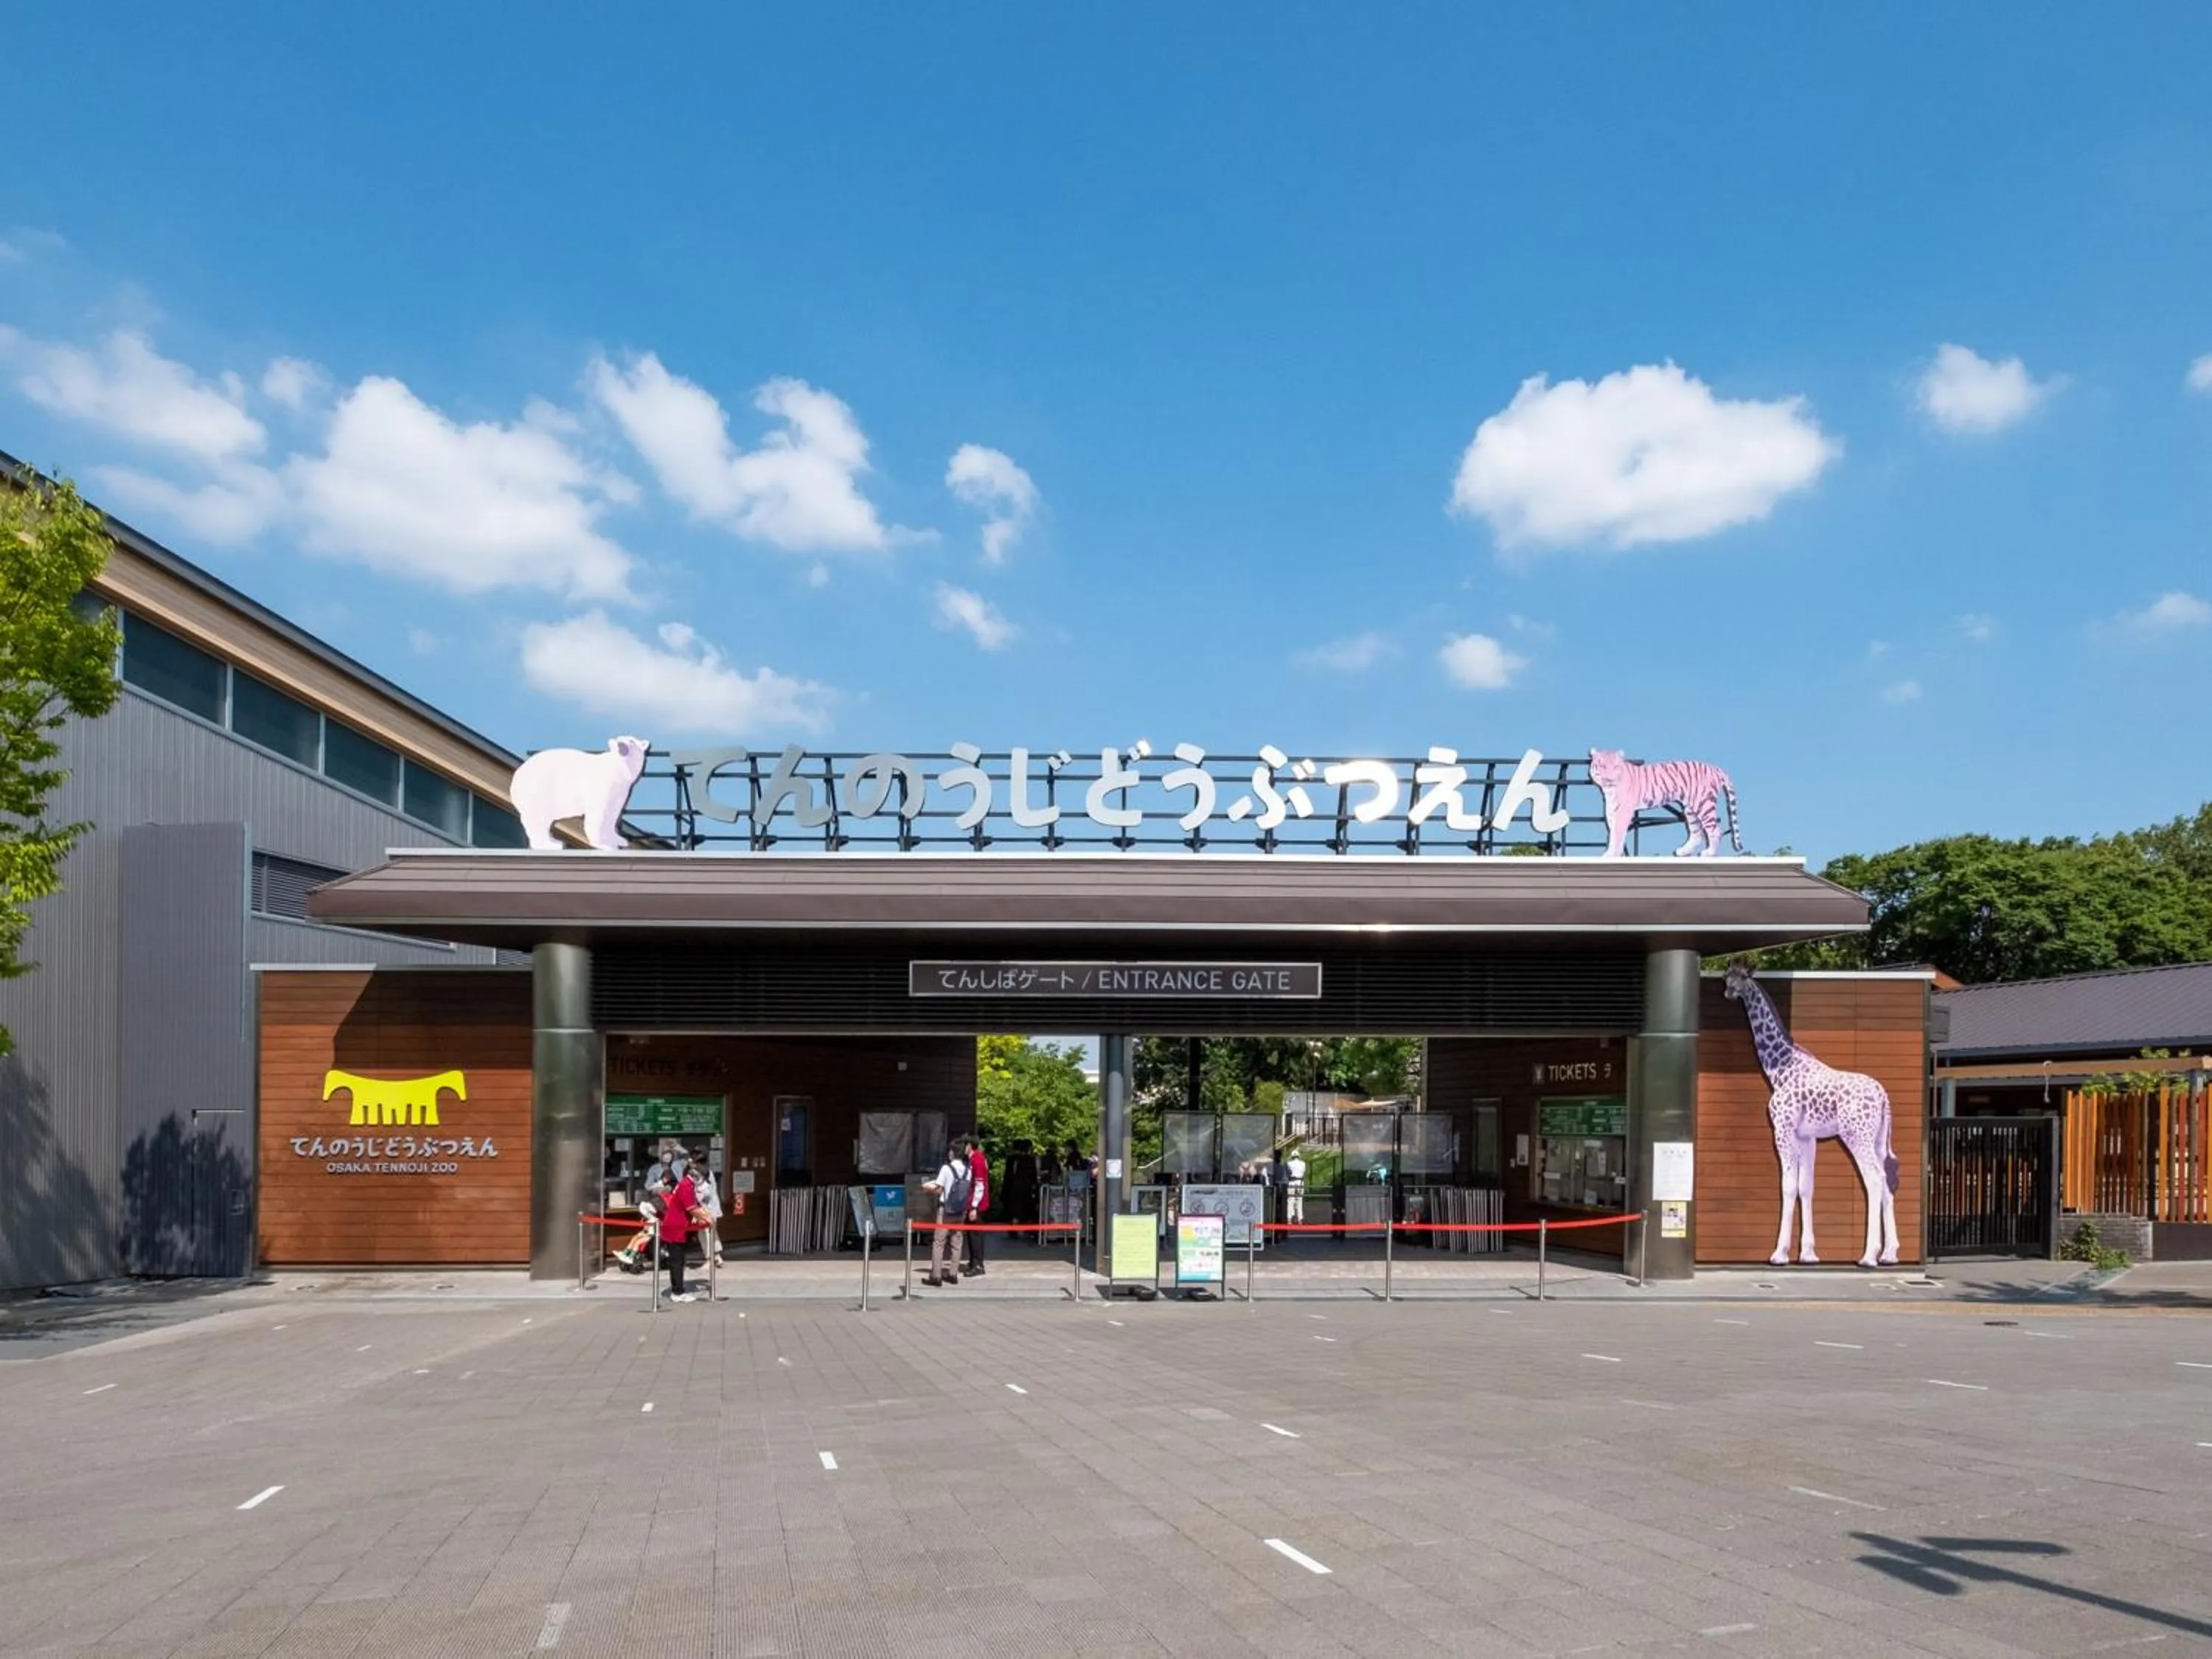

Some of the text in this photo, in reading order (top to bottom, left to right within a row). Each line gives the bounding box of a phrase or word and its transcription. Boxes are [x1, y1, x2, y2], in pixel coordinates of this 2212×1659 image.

[669, 740, 1570, 832] てんのうじどうぶつえん
[937, 968, 1074, 990] てんしばゲート
[1098, 970, 1222, 990] ENTRANCE
[1231, 970, 1291, 990] GATE
[608, 1055, 676, 1077] TICKETS
[1548, 1062, 1596, 1081] TICKETS
[290, 1136, 498, 1158] てんのうじどうぶつえん
[327, 1162, 458, 1173] OSAKA TENNOJI ZOO
